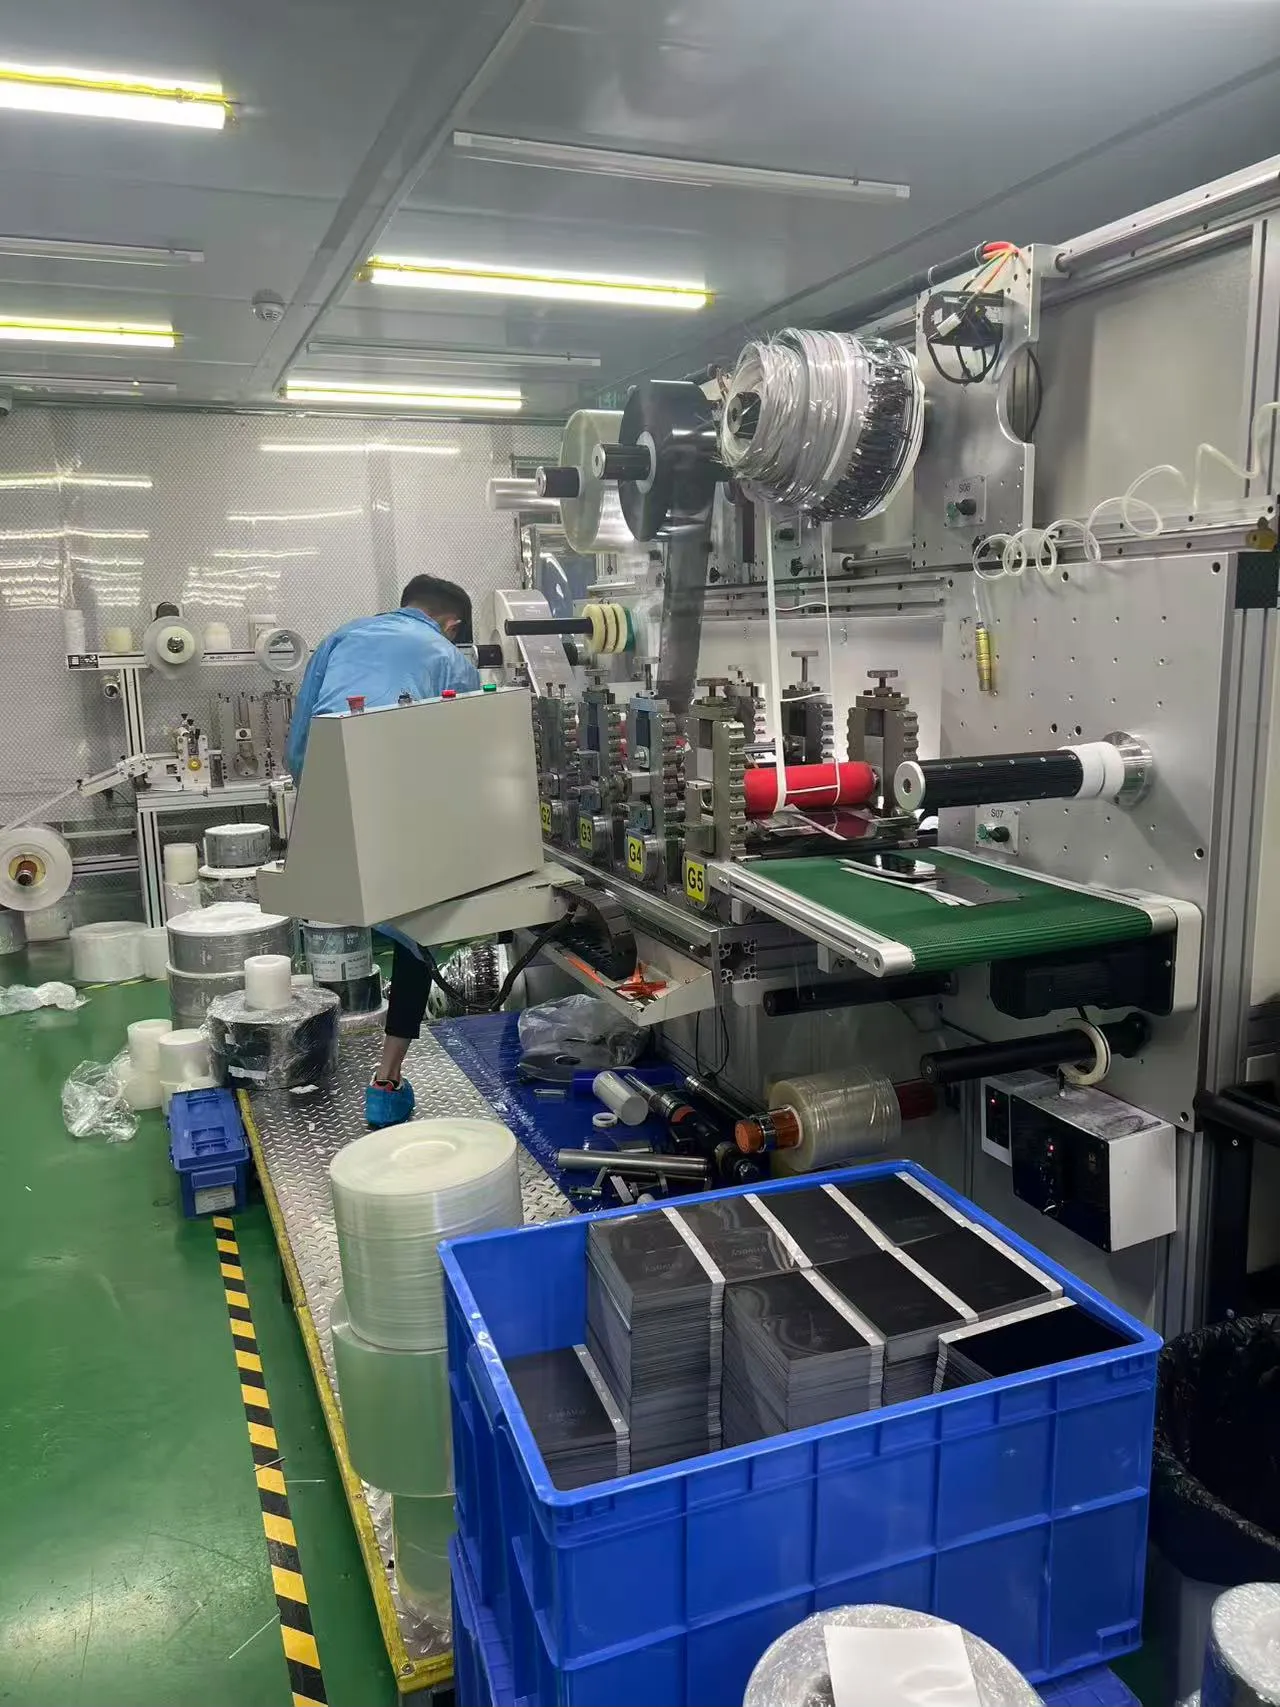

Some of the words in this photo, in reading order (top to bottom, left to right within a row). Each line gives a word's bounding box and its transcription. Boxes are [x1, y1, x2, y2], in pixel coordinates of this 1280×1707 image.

[541, 806, 550, 825] G2
[990, 808, 1004, 818] S07
[581, 823, 592, 842] G3
[629, 843, 642, 864] G4
[687, 866, 704, 892] G5
